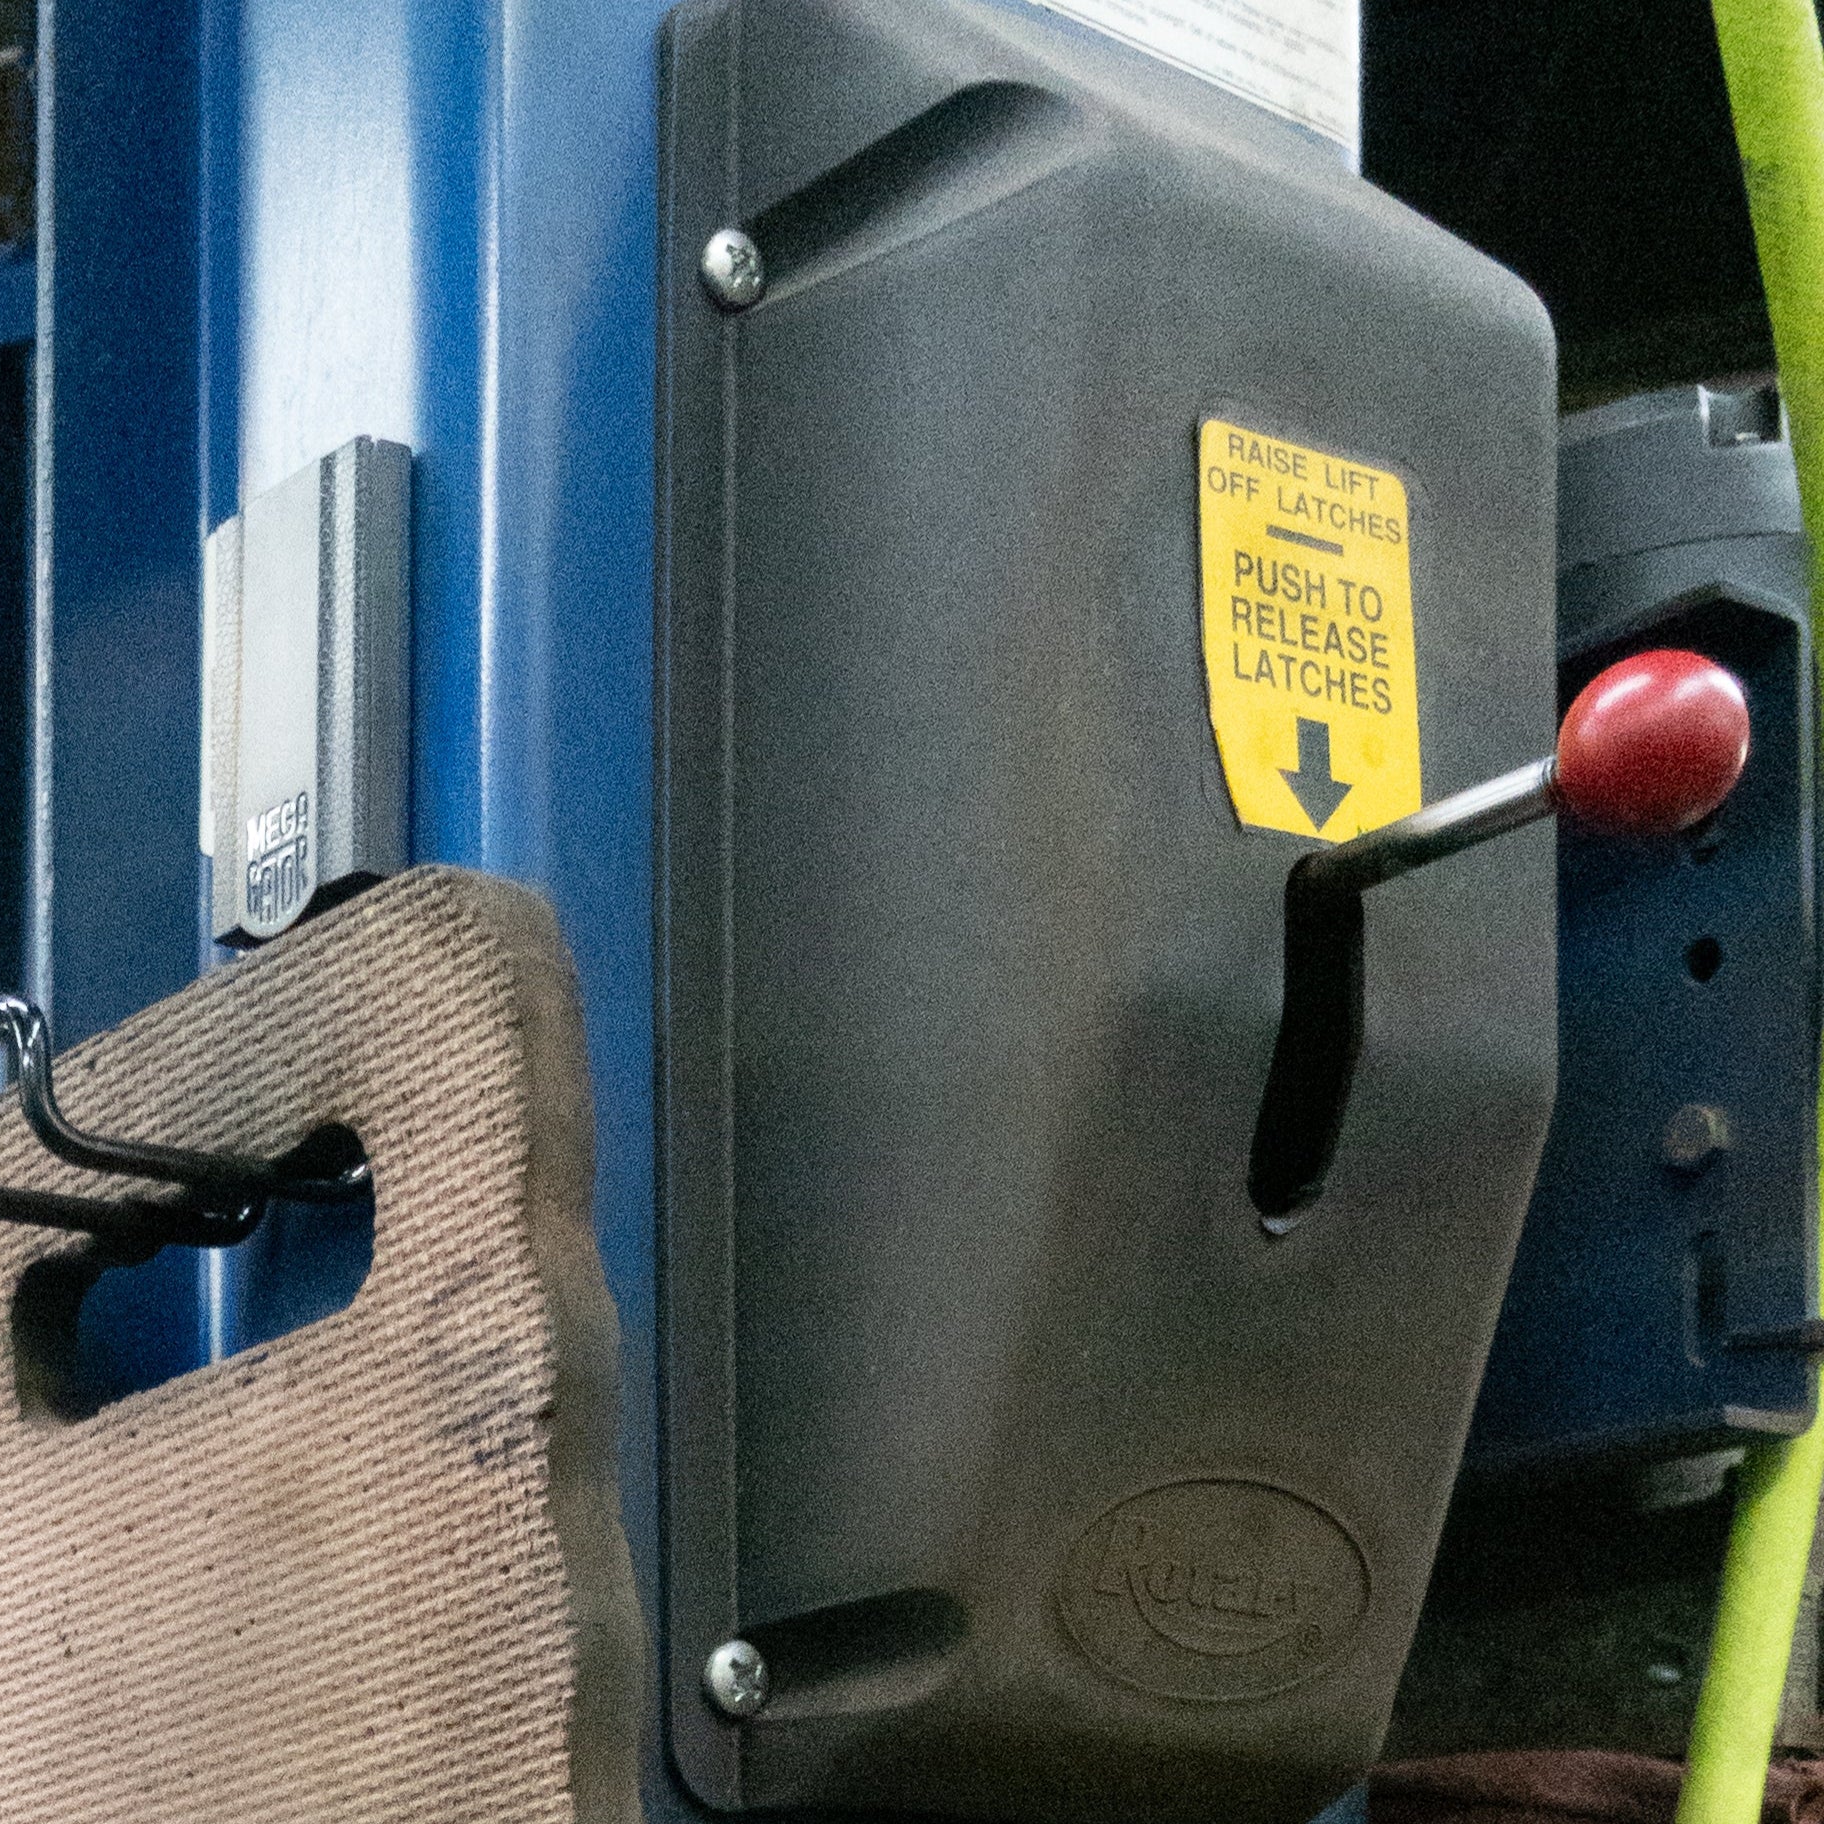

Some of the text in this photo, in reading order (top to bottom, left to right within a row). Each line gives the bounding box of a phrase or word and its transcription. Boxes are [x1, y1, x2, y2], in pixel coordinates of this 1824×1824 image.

[1227, 433, 1379, 500] RAISE LIFT
[1207, 466, 1402, 544] OFF LATCHES
[1234, 550, 1384, 622] PUSH TO
[1232, 597, 1389, 670] RELEASE
[1233, 642, 1393, 715] LATCHES
[247, 791, 309, 860] MEGA
